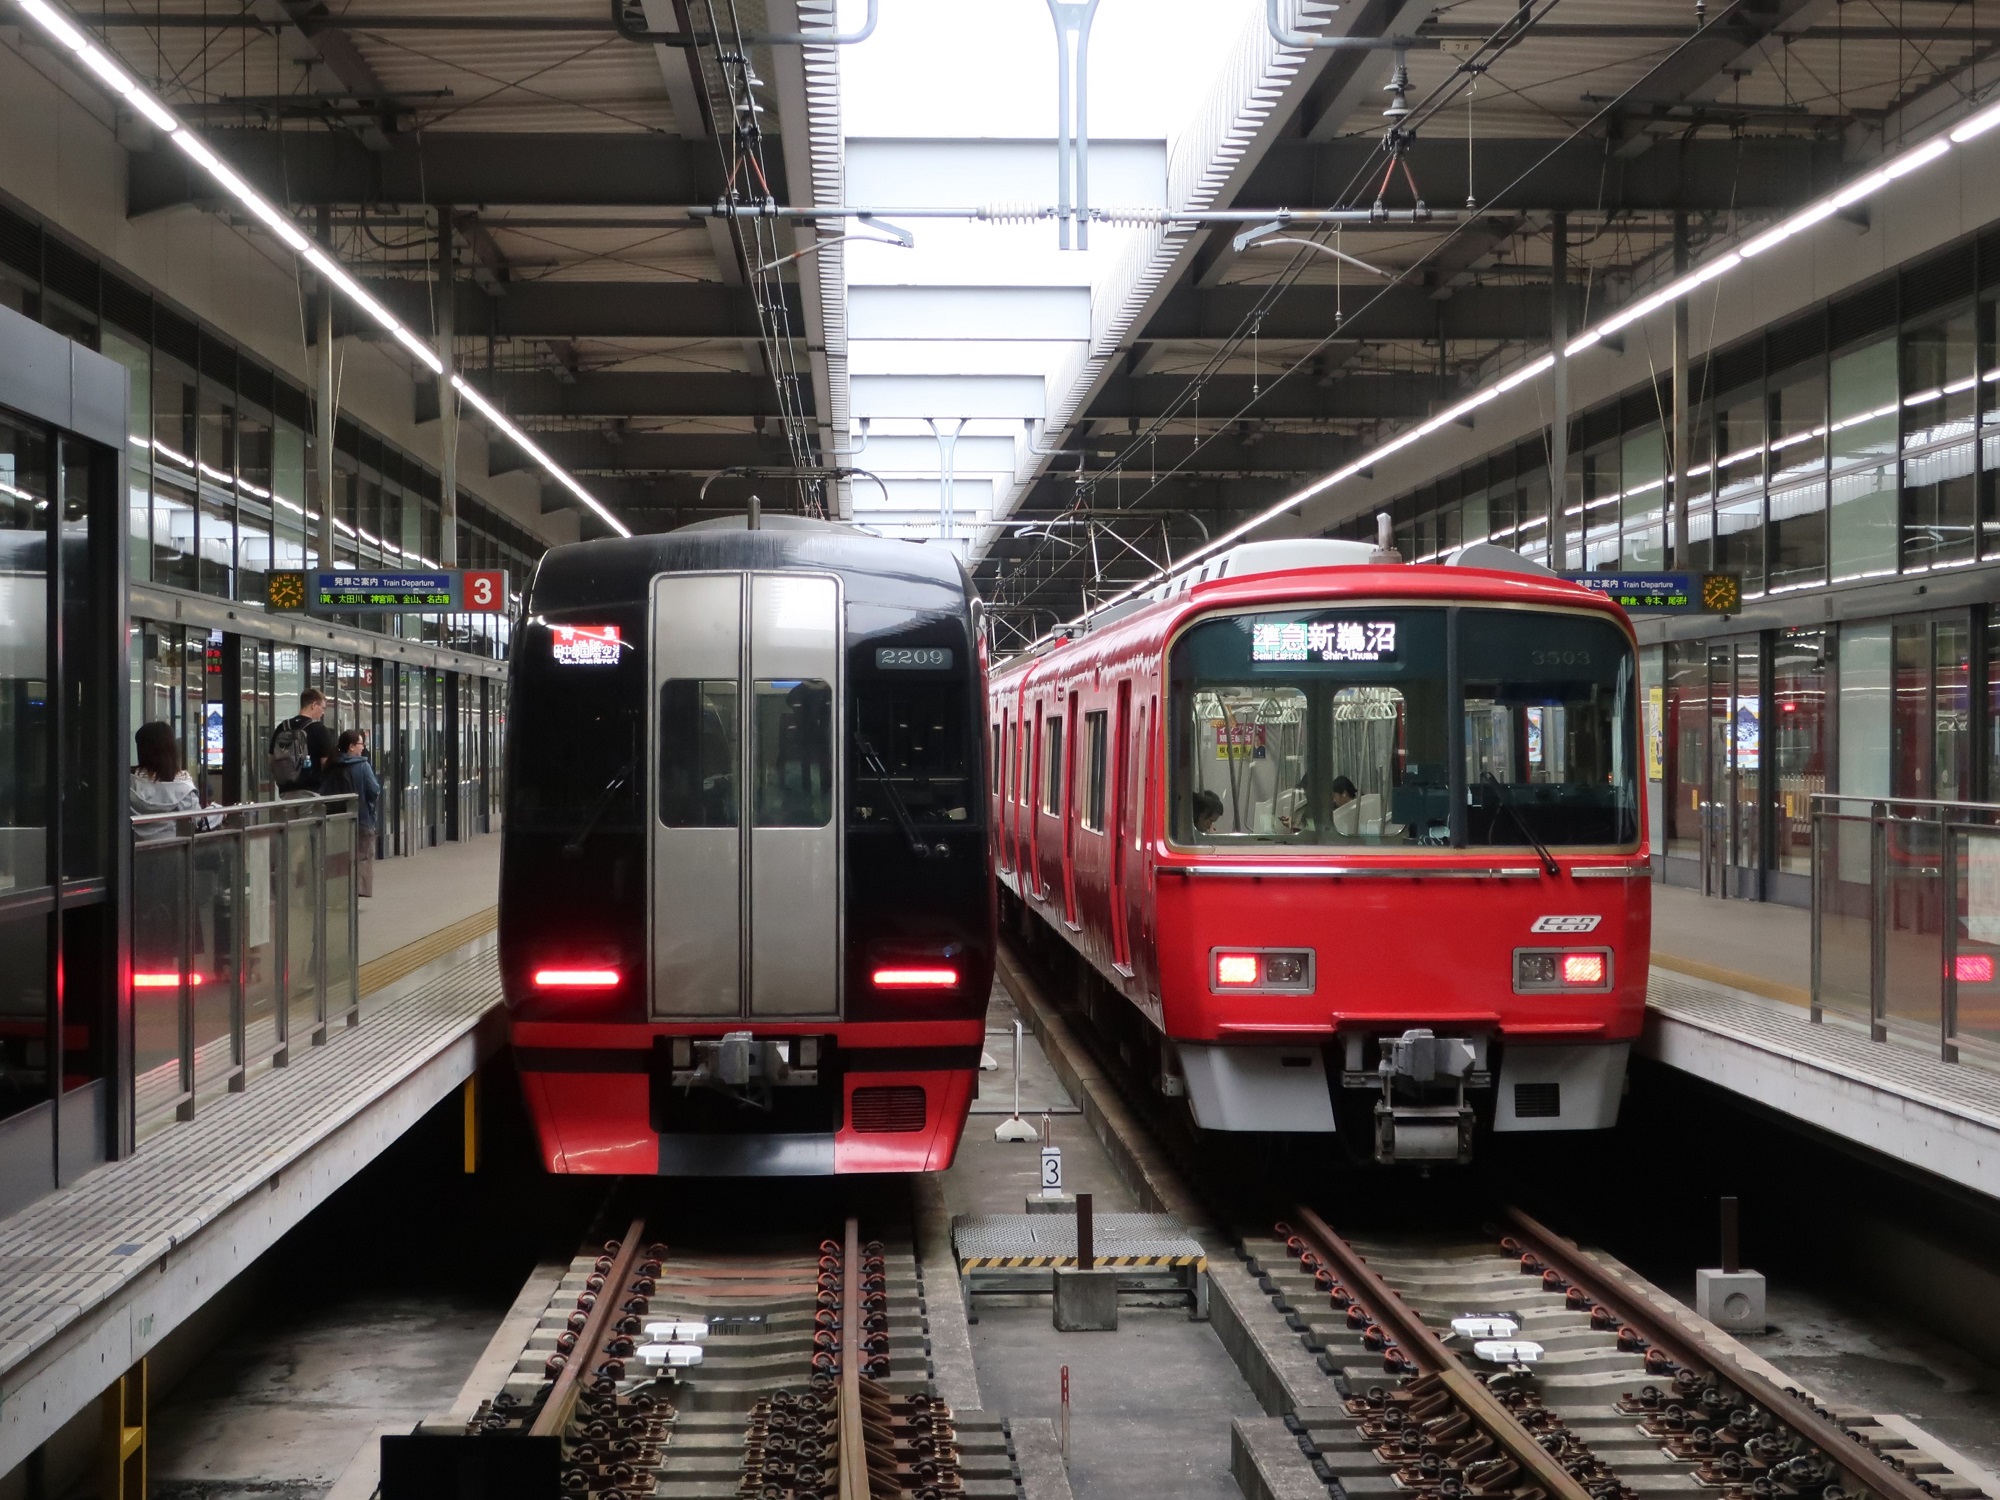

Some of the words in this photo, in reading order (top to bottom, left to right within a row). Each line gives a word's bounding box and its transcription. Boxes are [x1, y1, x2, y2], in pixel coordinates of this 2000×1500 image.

[334, 577, 379, 587] 発車ご案内
[382, 579, 399, 587] Train
[401, 579, 435, 589] Departure
[1641, 581, 1674, 590] Departure
[473, 578, 492, 605] 3
[1253, 623, 1307, 651] 準急
[1308, 622, 1396, 652] 新鵜沼
[881, 649, 944, 665] 2209
[1275, 651, 1307, 661] Express
[1322, 650, 1379, 661] Shin-Unuma
[1531, 650, 1591, 666] 3503
[1045, 1159, 1059, 1185] 3
